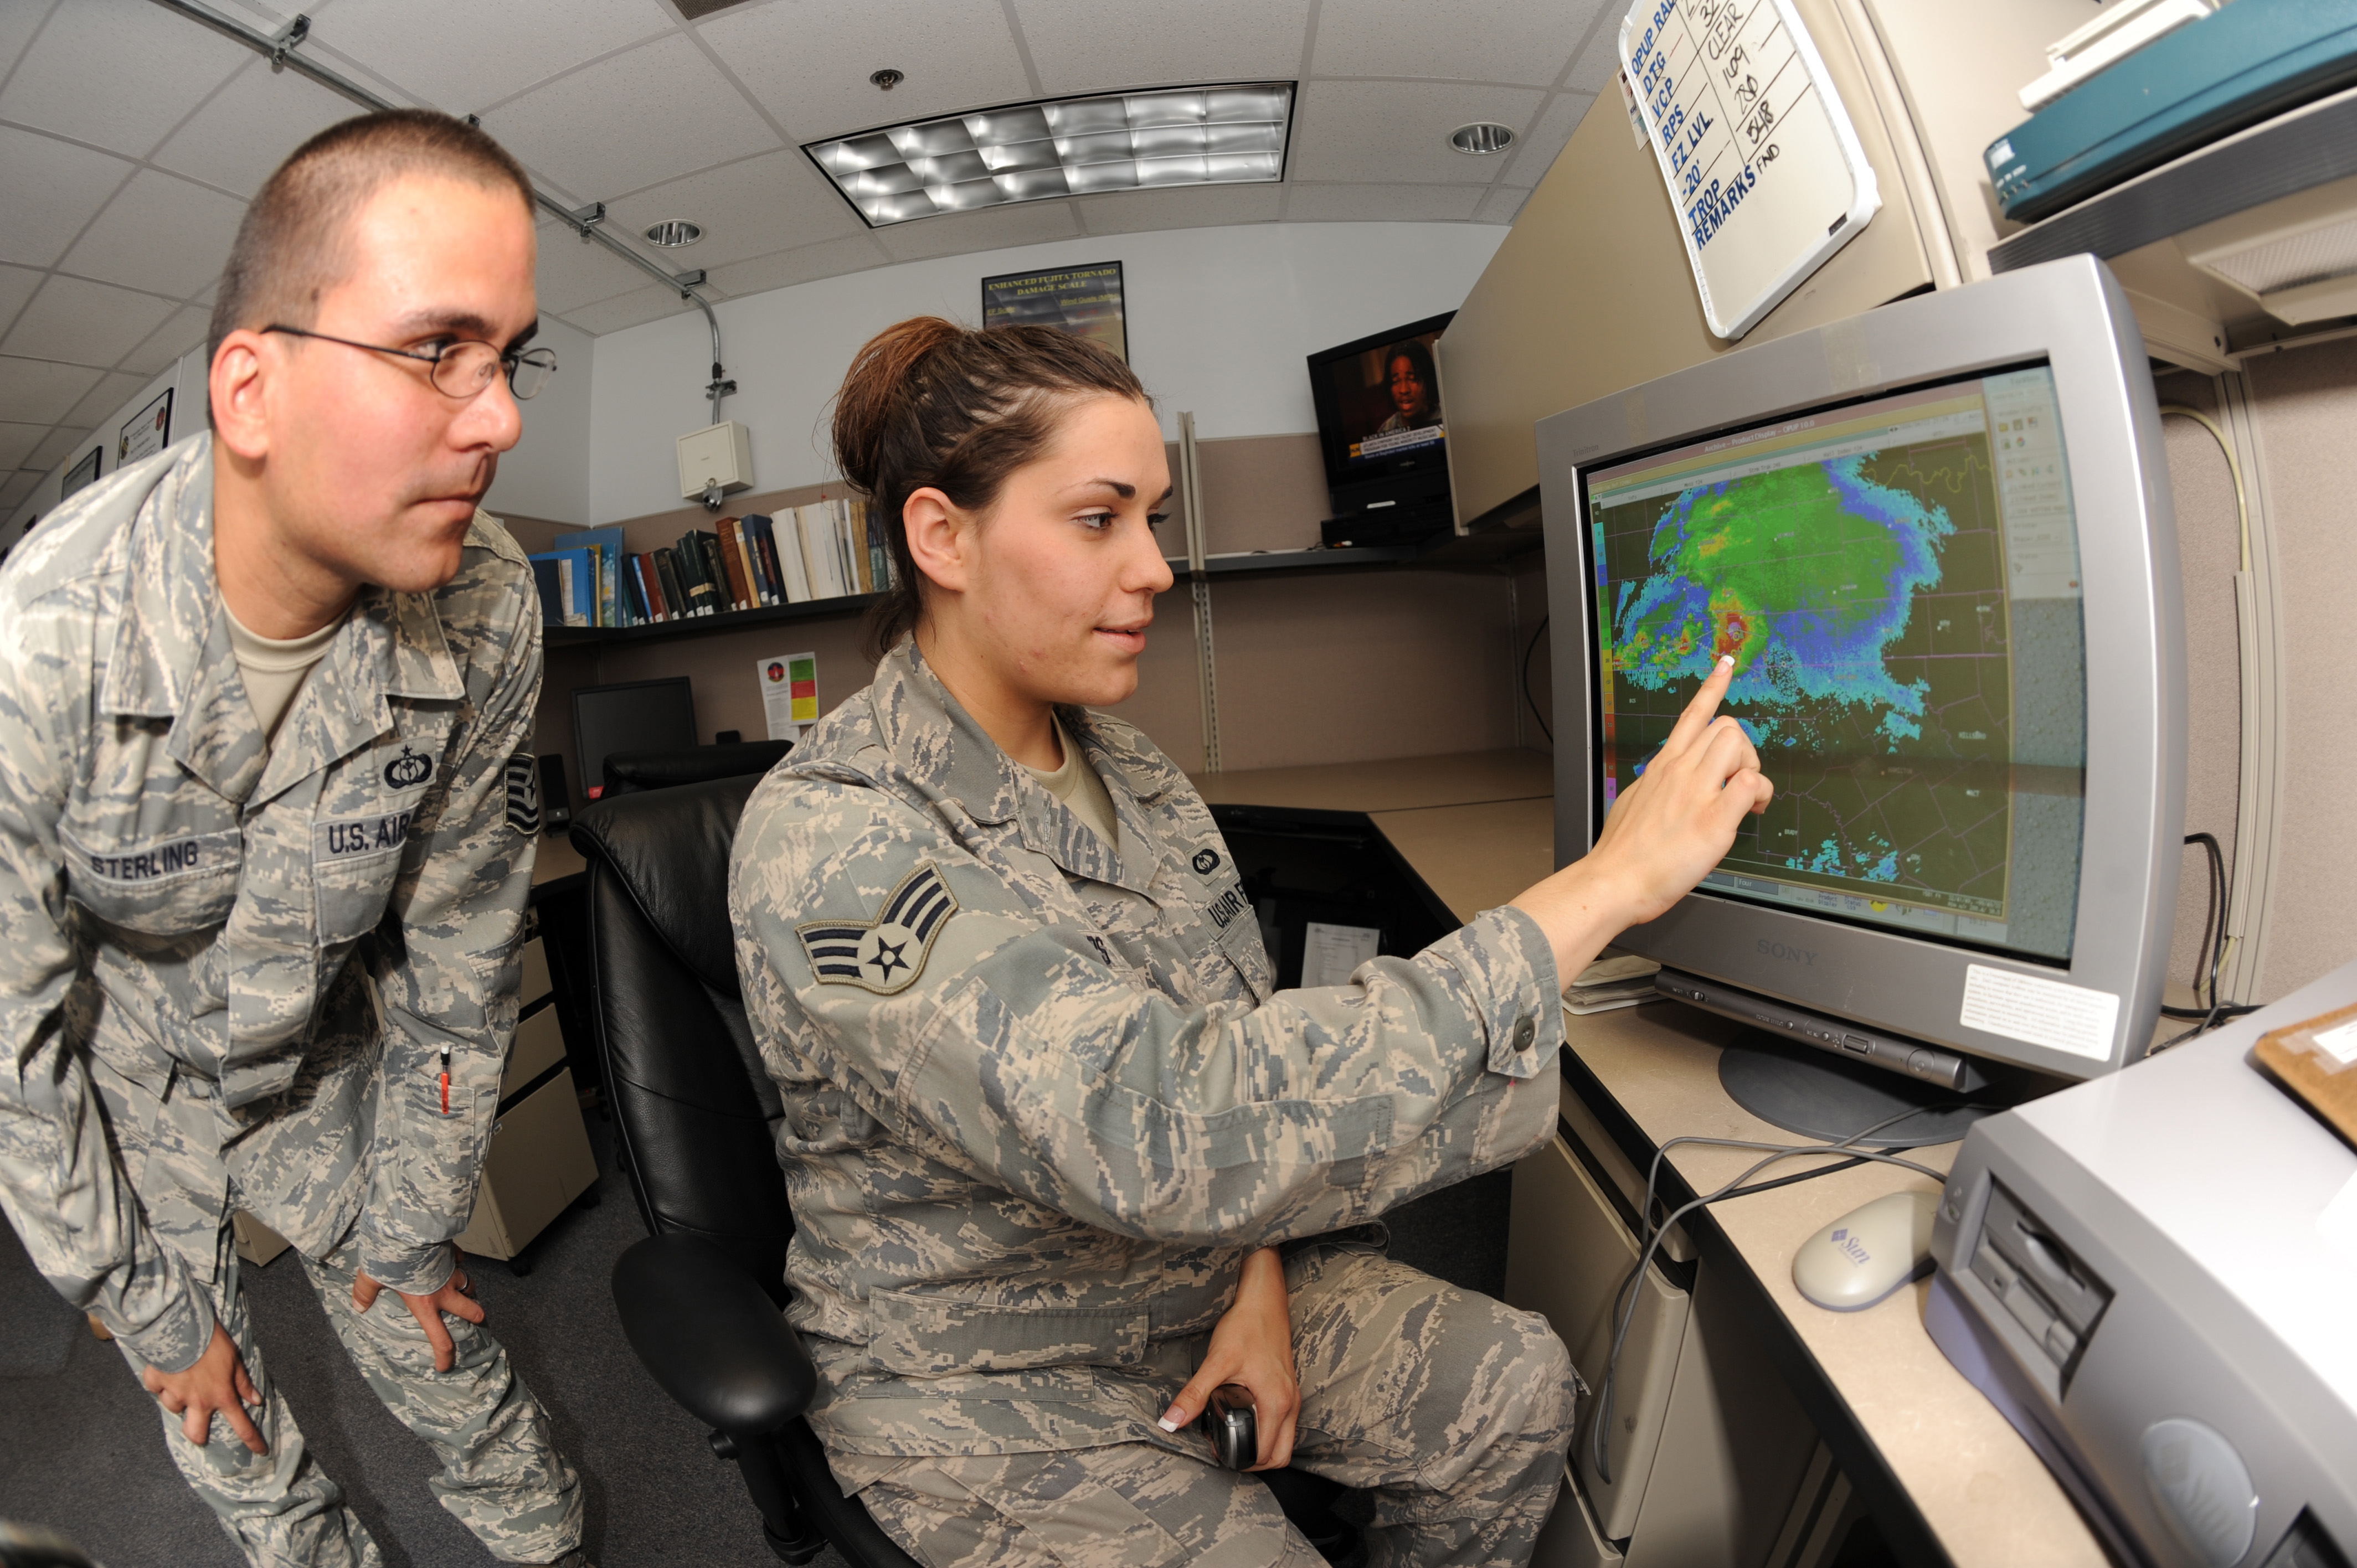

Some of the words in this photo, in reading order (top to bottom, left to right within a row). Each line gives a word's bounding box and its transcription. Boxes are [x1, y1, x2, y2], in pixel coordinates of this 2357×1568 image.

[1632, 27, 1654, 75] OPUP
[1708, 3, 1744, 60] CLEAR
[1643, 51, 1666, 95] DTG
[1652, 77, 1673, 118] VCP
[1662, 104, 1684, 146] RPS
[1671, 142, 1688, 173] FZ
[1687, 111, 1713, 147] LVL
[1688, 178, 1720, 228] TROP
[1694, 164, 1756, 251] REMARKS
[989, 277, 1037, 291] ENHANCED
[1039, 273, 1070, 284] FUJITA
[1072, 268, 1116, 280] TORNADO
[1017, 283, 1055, 296] DAMAGE
[1058, 281, 1087, 291] SCALE
[1573, 443, 1599, 457] Trinitron
[1705, 437, 1726, 453] Archive
[1732, 433, 1754, 446] Product
[1754, 429, 1777, 442] Display
[1783, 422, 1799, 433] OPUP
[329, 823, 369, 854] U.S.
[375, 813, 410, 848] AIR
[91, 840, 198, 880] STERLING
[1739, 879, 1753, 888] Four
[1757, 939, 1819, 967] SONY
[1841, 1236, 1870, 1265] Sun
